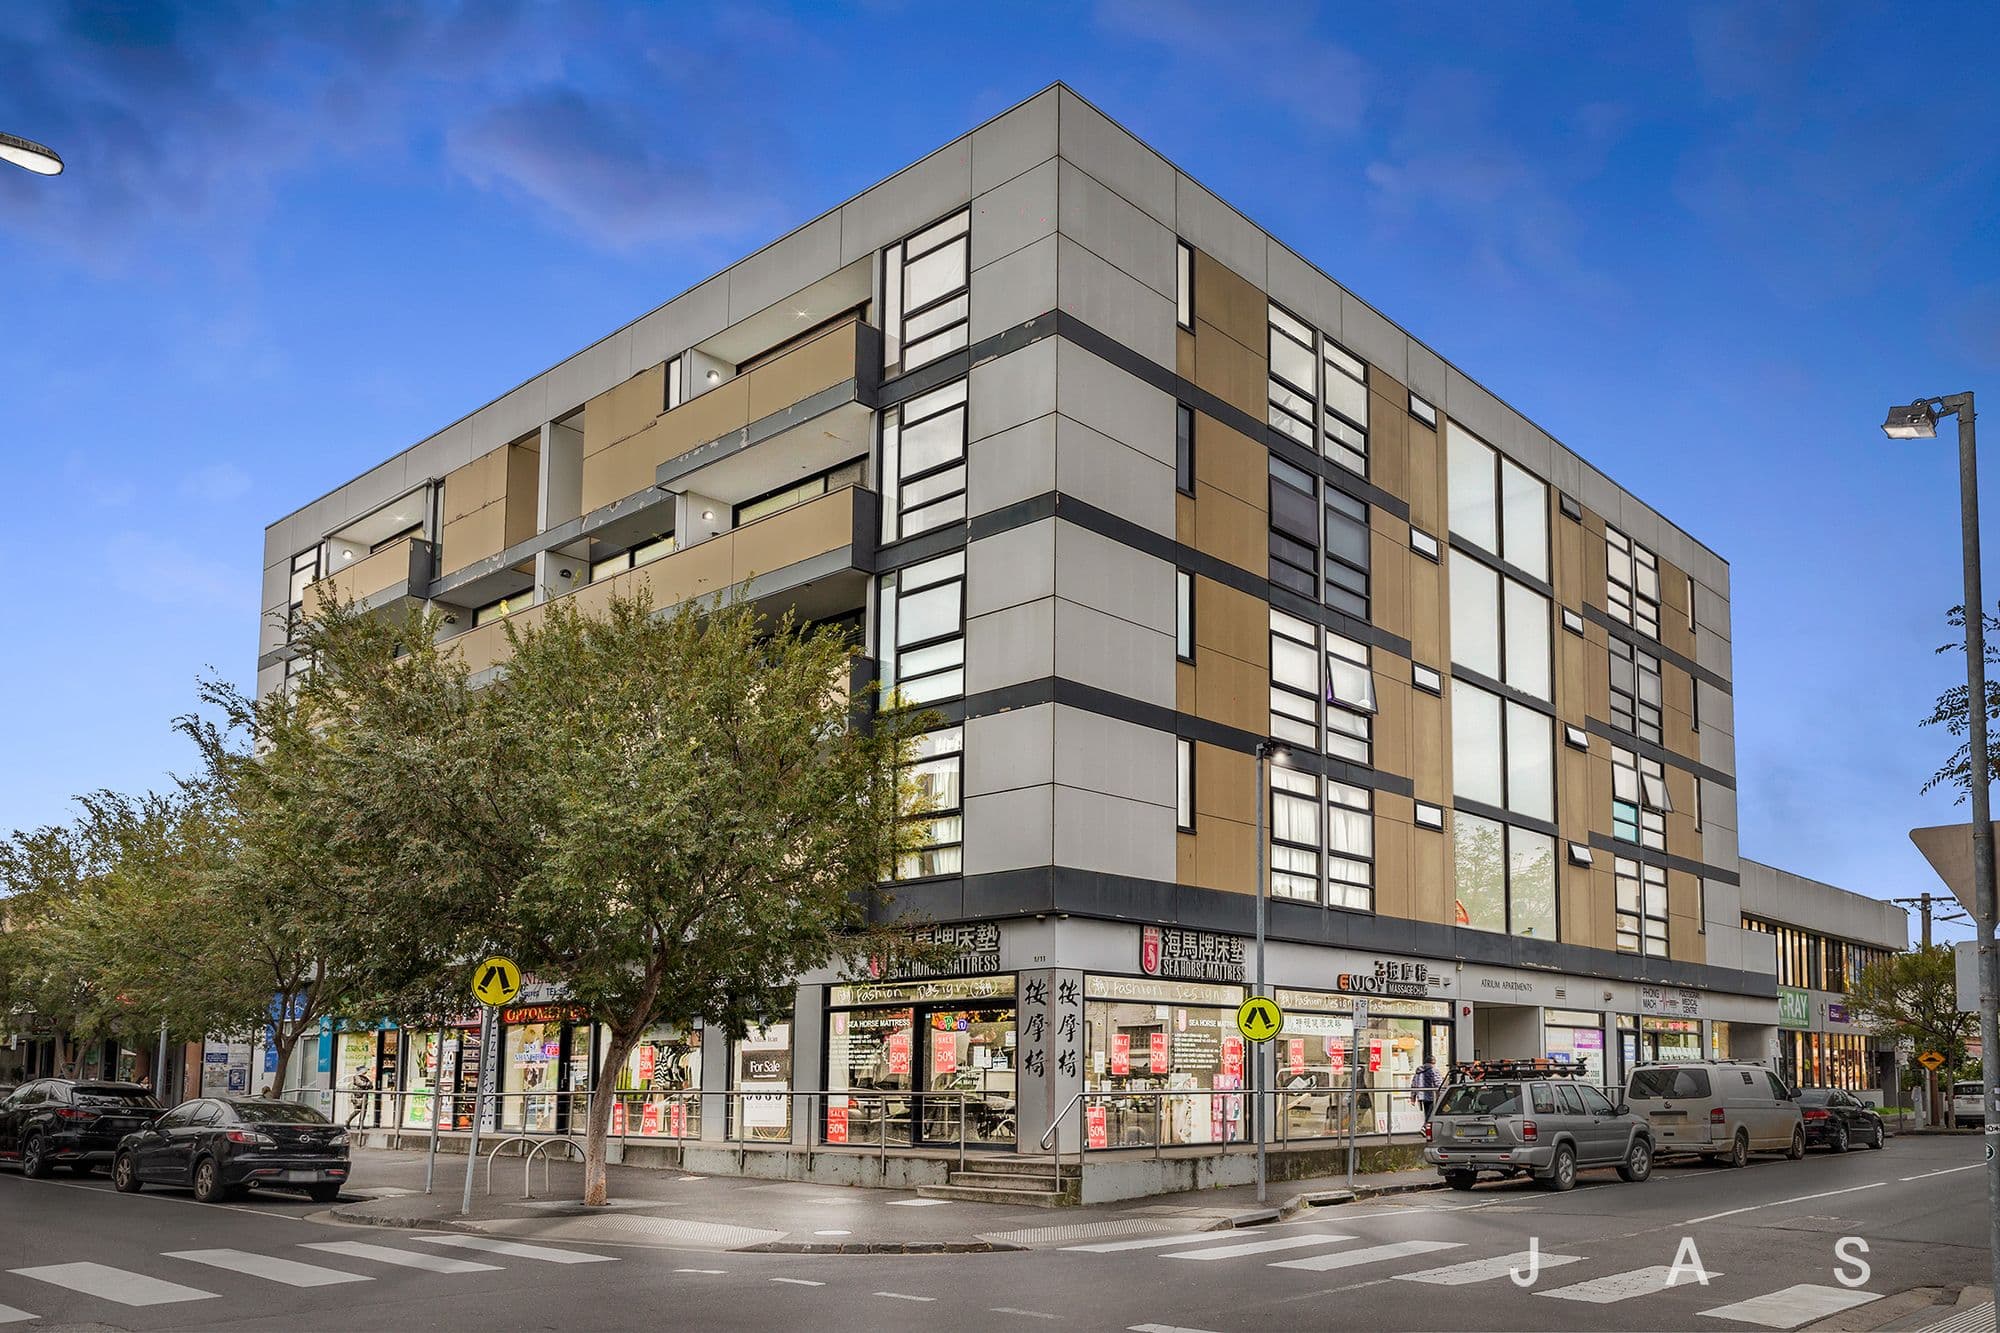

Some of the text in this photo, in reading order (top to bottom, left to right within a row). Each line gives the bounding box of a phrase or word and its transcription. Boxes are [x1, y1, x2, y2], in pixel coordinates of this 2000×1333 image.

[1163, 928, 1244, 963] 海馬牌床墊
[1163, 959, 1246, 981] SEA HORSE MATTRESS
[1338, 974, 1385, 992] ENJOY
[1024, 978, 1049, 1078] 按摩椅
[1057, 978, 1080, 1078] 按摩椅
[937, 1051, 954, 1062] 50%
[750, 1060, 780, 1073] For Sale
[829, 1123, 845, 1134] 50%
[1090, 1126, 1104, 1137] 50%
